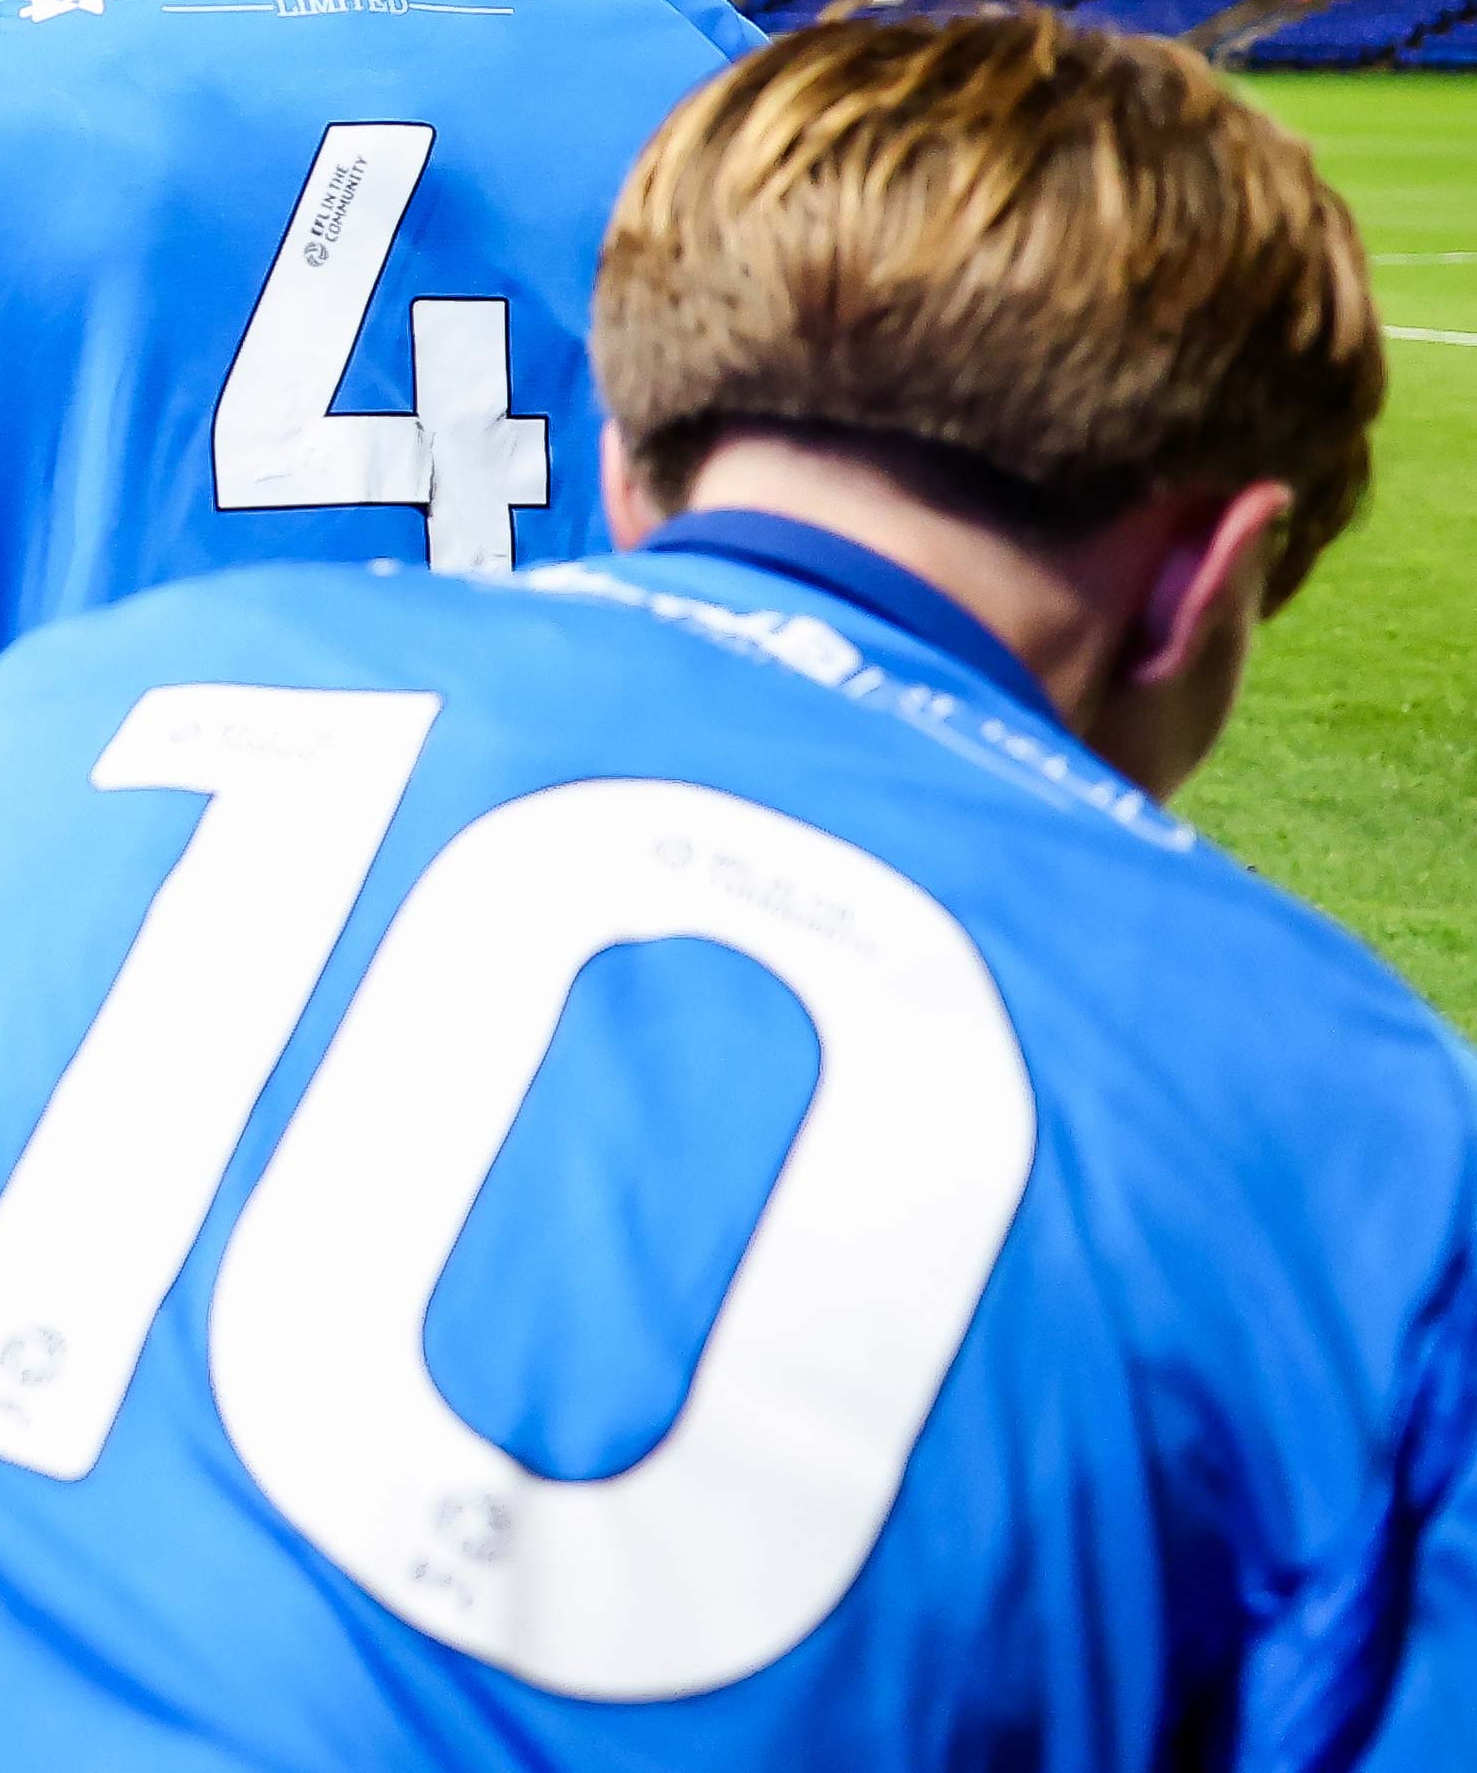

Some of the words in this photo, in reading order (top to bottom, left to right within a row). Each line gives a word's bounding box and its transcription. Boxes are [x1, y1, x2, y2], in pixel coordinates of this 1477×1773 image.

[328, 163, 350, 191] THE
[320, 192, 337, 212] IN
[324, 154, 368, 243] COMMUNITY
[311, 212, 331, 237] EFL
[214, 120, 550, 573] 4
